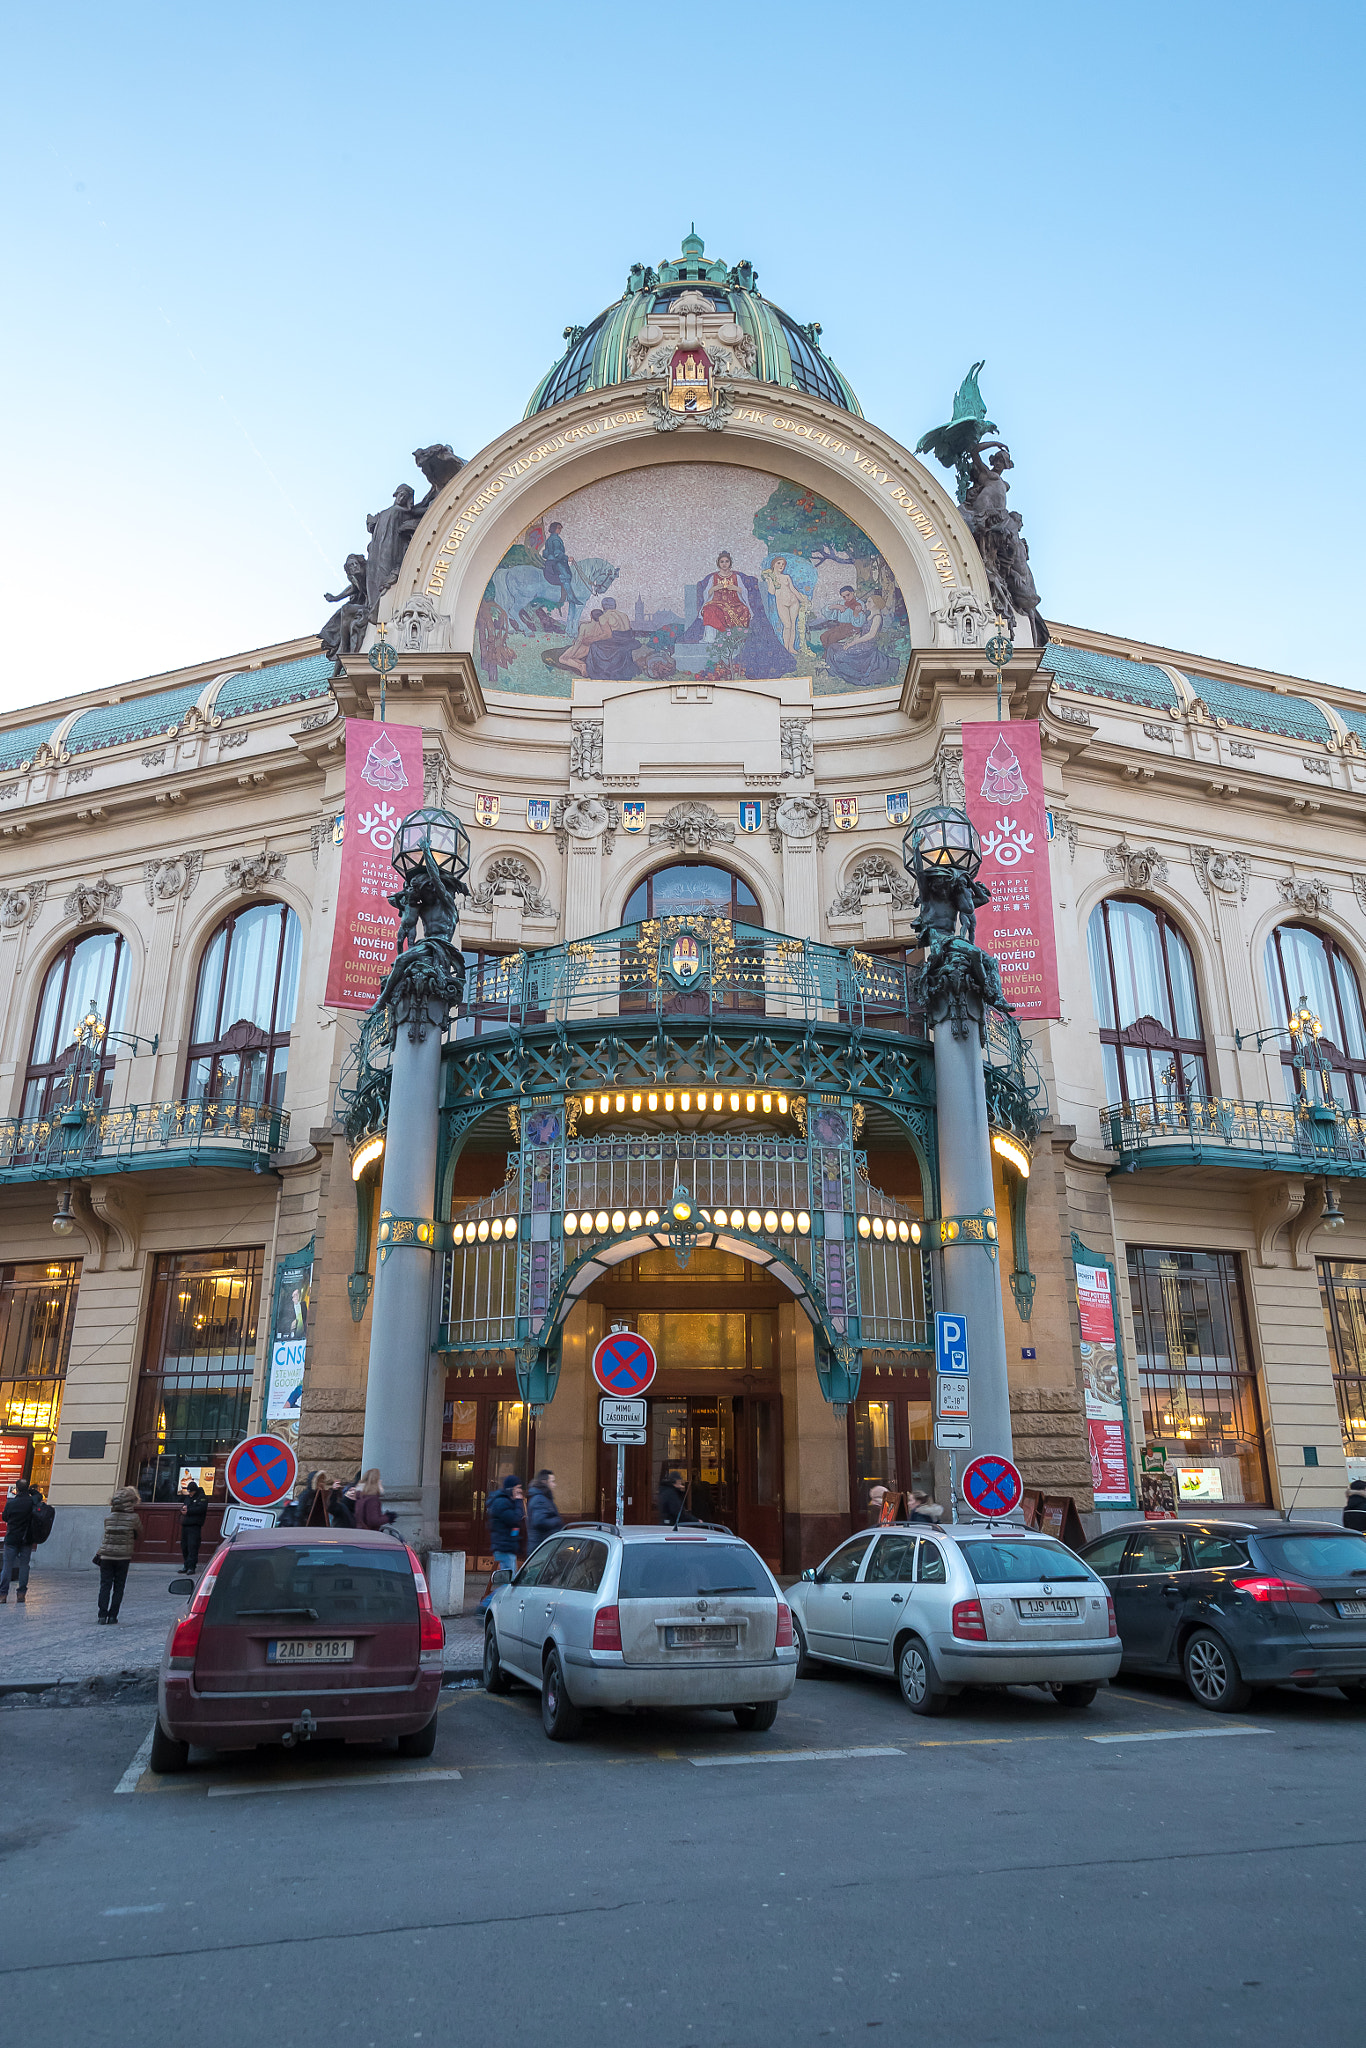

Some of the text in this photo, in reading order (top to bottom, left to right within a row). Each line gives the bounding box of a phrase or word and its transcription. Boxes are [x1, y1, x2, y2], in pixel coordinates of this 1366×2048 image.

[733, 408, 768, 425] JAK
[772, 416, 850, 456] ODOLALAS
[425, 559, 451, 597] ZDAR
[501, 437, 565, 480] VZDORUJ
[362, 868, 399, 882] CHINESE
[361, 877, 399, 890] NEW YEAR
[991, 879, 1029, 887] HAPPY
[991, 887, 1029, 895] CHINESE
[992, 895, 1009, 903] NEW
[357, 912, 396, 926] OSLAVA
[993, 928, 1033, 938] OSLAVA
[353, 936, 395, 951] NOVÉHO
[988, 937, 1040, 950] ČÍNSKÉHO
[358, 950, 387, 962] ROKU
[993, 949, 1036, 961] NOVÉHO
[344, 960, 390, 975] OHNIVÉH
[1000, 962, 1030, 972] ROKU
[345, 973, 381, 986] KOHOU
[343, 989, 353, 997] 27.
[353, 991, 376, 1000] LEDNA
[943, 1321, 961, 1354] P
[615, 1404, 632, 1412] MIMO
[606, 1412, 641, 1423] ZÁSOBOVÁNÍ
[1028, 1600, 1073, 1612] 1J9 1401
[280, 1642, 304, 1657] 2AD
[315, 1642, 347, 1657] 8181
